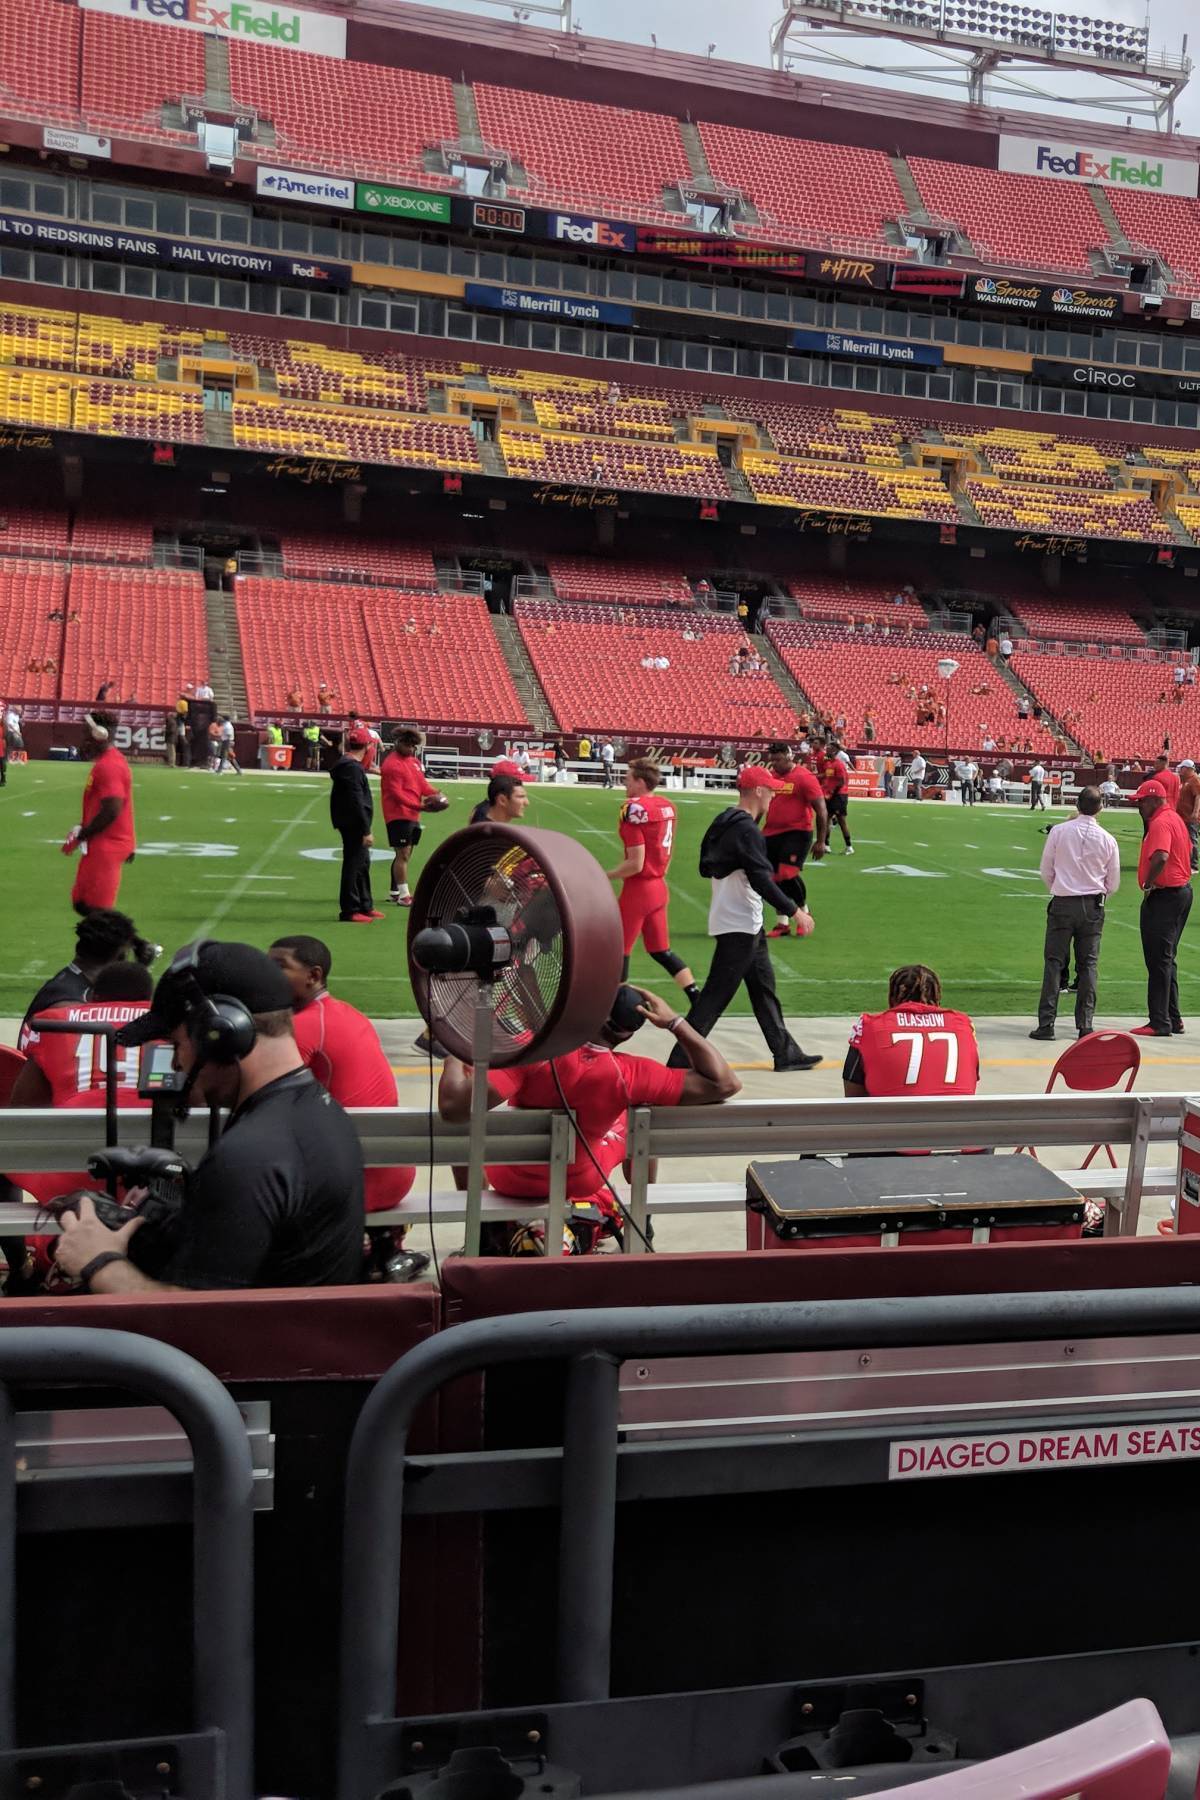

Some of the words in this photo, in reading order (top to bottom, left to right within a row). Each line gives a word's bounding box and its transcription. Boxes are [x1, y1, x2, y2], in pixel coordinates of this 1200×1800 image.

[1036, 146, 1164, 188] FedExField
[276, 176, 350, 200] Ameritel
[382, 195, 416, 212] XBOX
[416, 200, 444, 215] ONE
[556, 215, 627, 249] FedEx
[12, 220, 34, 237] TO
[37, 225, 115, 249] REDSKINS
[118, 238, 161, 256] FANS.
[172, 247, 206, 262] HAIL
[208, 252, 273, 272] VICTORY!
[292, 263, 329, 280] FedEx
[977, 293, 1038, 309] WASHINGTON
[995, 281, 1042, 300] Sports
[1071, 291, 1117, 309] Sports
[519, 293, 561, 314] Merrill
[564, 301, 599, 319] Lynch
[1053, 303, 1114, 318] WASHINGTON
[843, 338, 880, 356] Merrill
[882, 343, 914, 360] Lynch
[1073, 367, 1137, 389] CÎROC
[115, 726, 167, 750] 942
[662, 819, 674, 855] 4
[896, 1012, 946, 1029] GLASGOW
[891, 1031, 960, 1086] 77
[897, 1440, 1010, 1474] DIAGEO
[1018, 1433, 1118, 1464] DREAM
